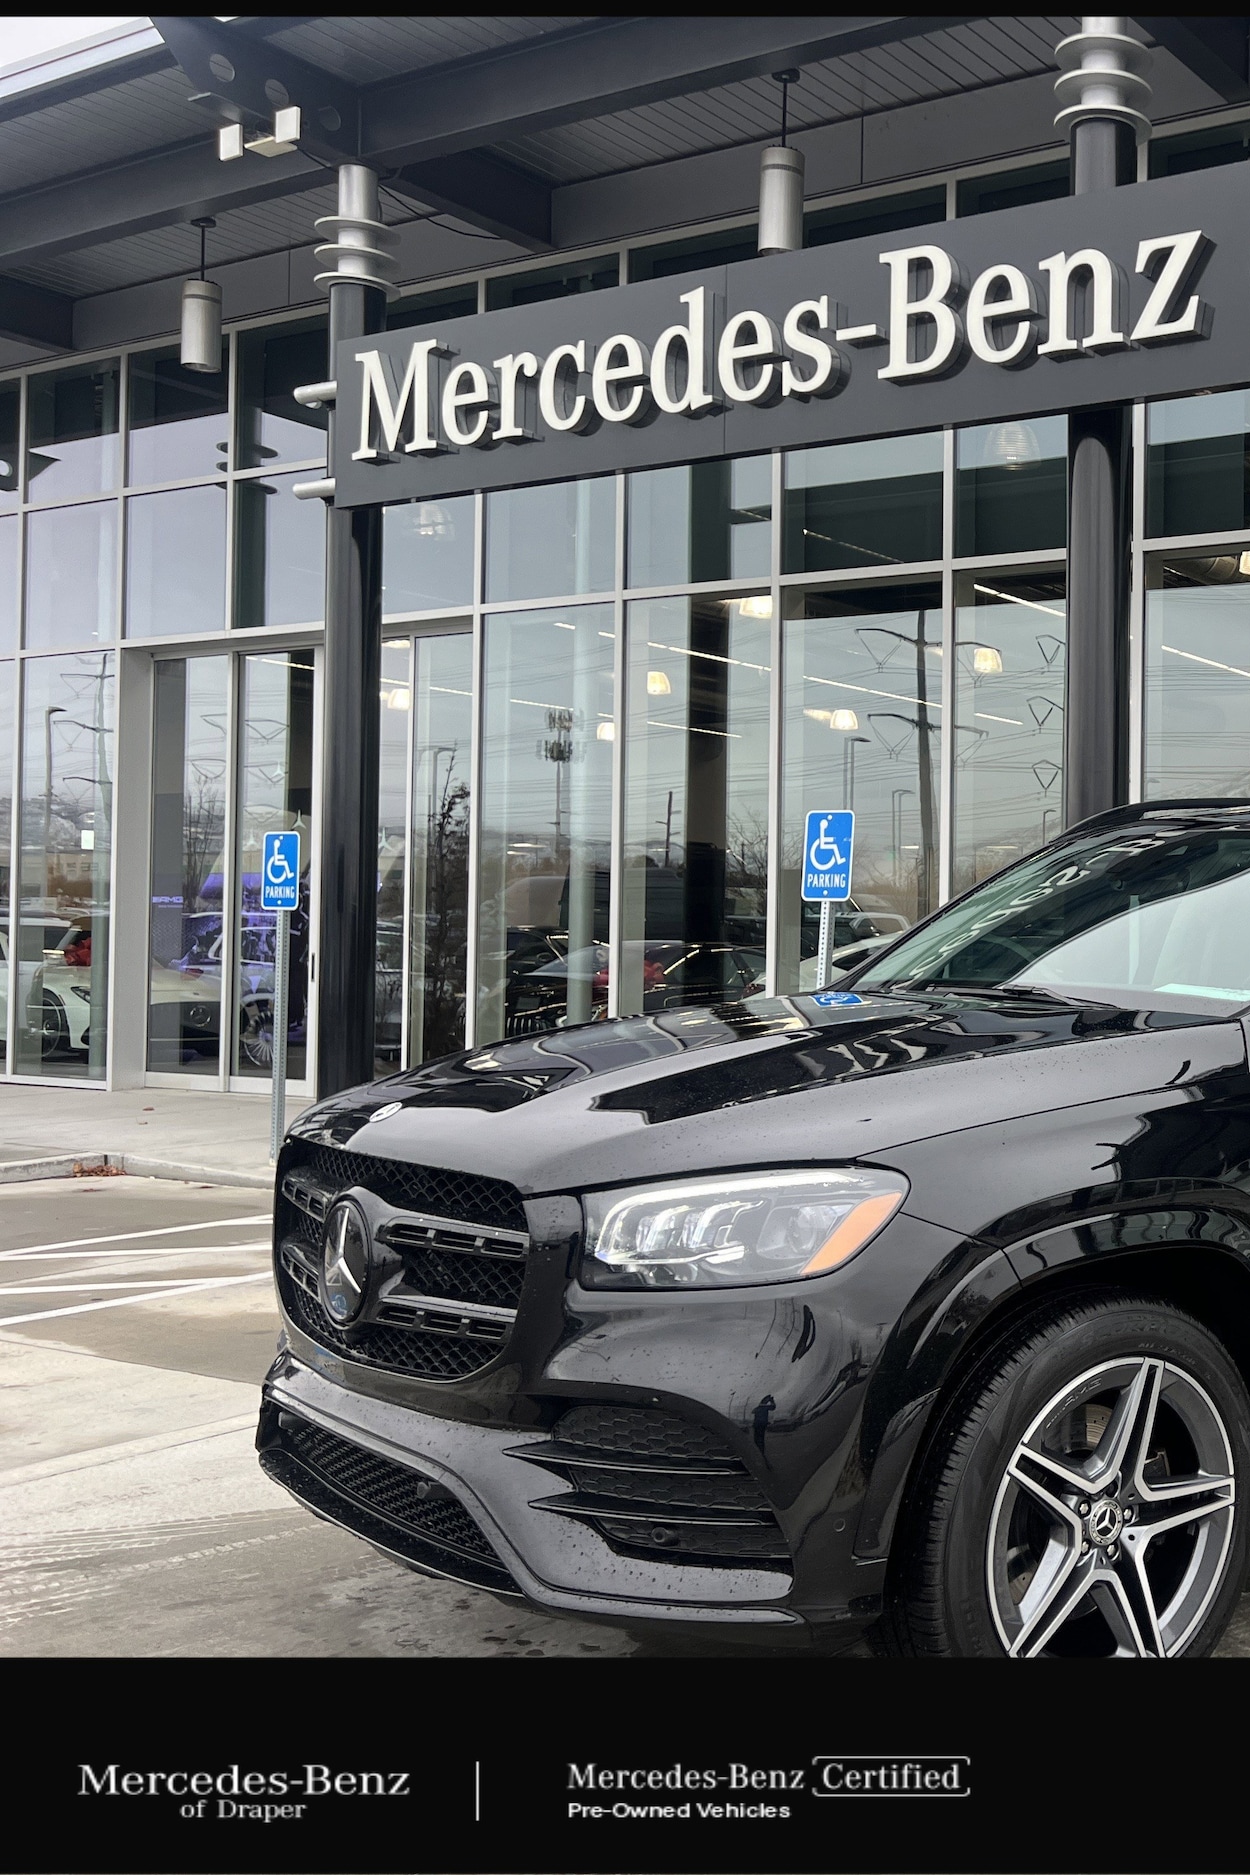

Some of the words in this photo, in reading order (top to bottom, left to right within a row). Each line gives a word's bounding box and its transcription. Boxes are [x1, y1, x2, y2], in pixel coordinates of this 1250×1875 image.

[351, 230, 1203, 461] Mercedes-Benz
[807, 873, 846, 888] PARKING
[265, 885, 295, 899] PARKING
